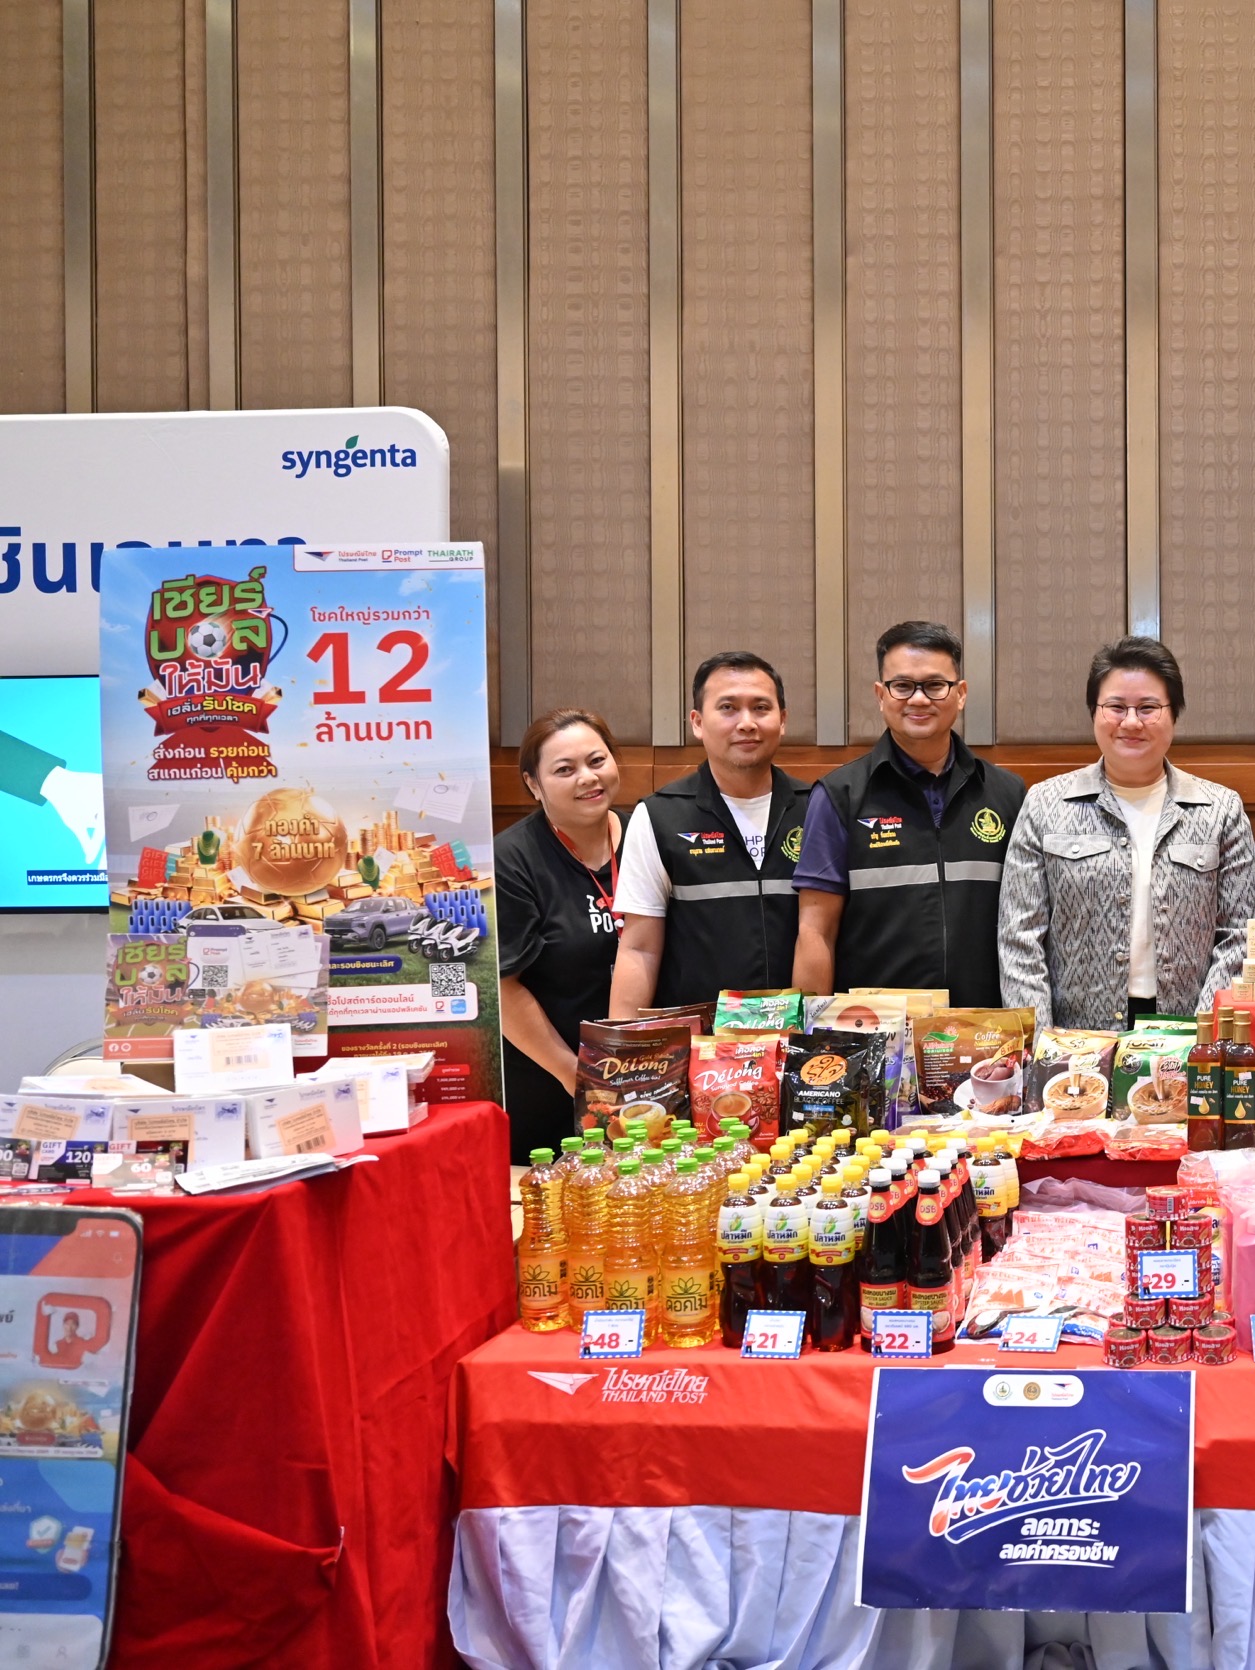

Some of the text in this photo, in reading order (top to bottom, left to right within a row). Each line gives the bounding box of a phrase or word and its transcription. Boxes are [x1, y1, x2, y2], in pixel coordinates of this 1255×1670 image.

[282, 443, 417, 478] syngenta
[394, 549, 423, 557] Prompt
[428, 549, 474, 557] THAIRATH
[152, 566, 267, 621] เชียร์
[310, 606, 431, 625] โชคใหญ่รวมกว่า
[306, 630, 432, 705] 12
[160, 658, 261, 697] ให้มัน
[186, 713, 239, 725] ทุกที่ทุกเวลา
[315, 711, 433, 743] ล้านบาท
[153, 742, 270, 760] ส่งก่อน รวยก่อน
[148, 762, 277, 783] สแกนก่อน คุ้มกว่า
[265, 814, 321, 837] ทองคำ
[252, 839, 336, 860] 7 ล้านบาท
[1194, 1081, 1214, 1089] HONEY
[1231, 1085, 1250, 1093] HONEY
[797, 1090, 841, 1098] AMERICANO
[66, 1151, 91, 1164] 120
[130, 1162, 152, 1173] 60
[721, 1229, 752, 1240] ปลาหมึก
[767, 1228, 798, 1239] ปลาหมึก
[814, 1231, 846, 1242] ปลาหมึก
[1151, 1273, 1176, 1289] 29
[666, 1293, 708, 1312] ดอกไม้
[593, 1333, 620, 1349] 48
[757, 1333, 778, 1349] 21
[885, 1333, 909, 1349] 22
[1012, 1332, 1037, 1344] 24
[602, 1367, 709, 1391] ไปรษณีย์ไทย
[602, 1391, 708, 1404] THAILAND POST
[1020, 1517, 1100, 1536] ลดภาระ
[999, 1540, 1119, 1561] ลดค่าครองชีพ
